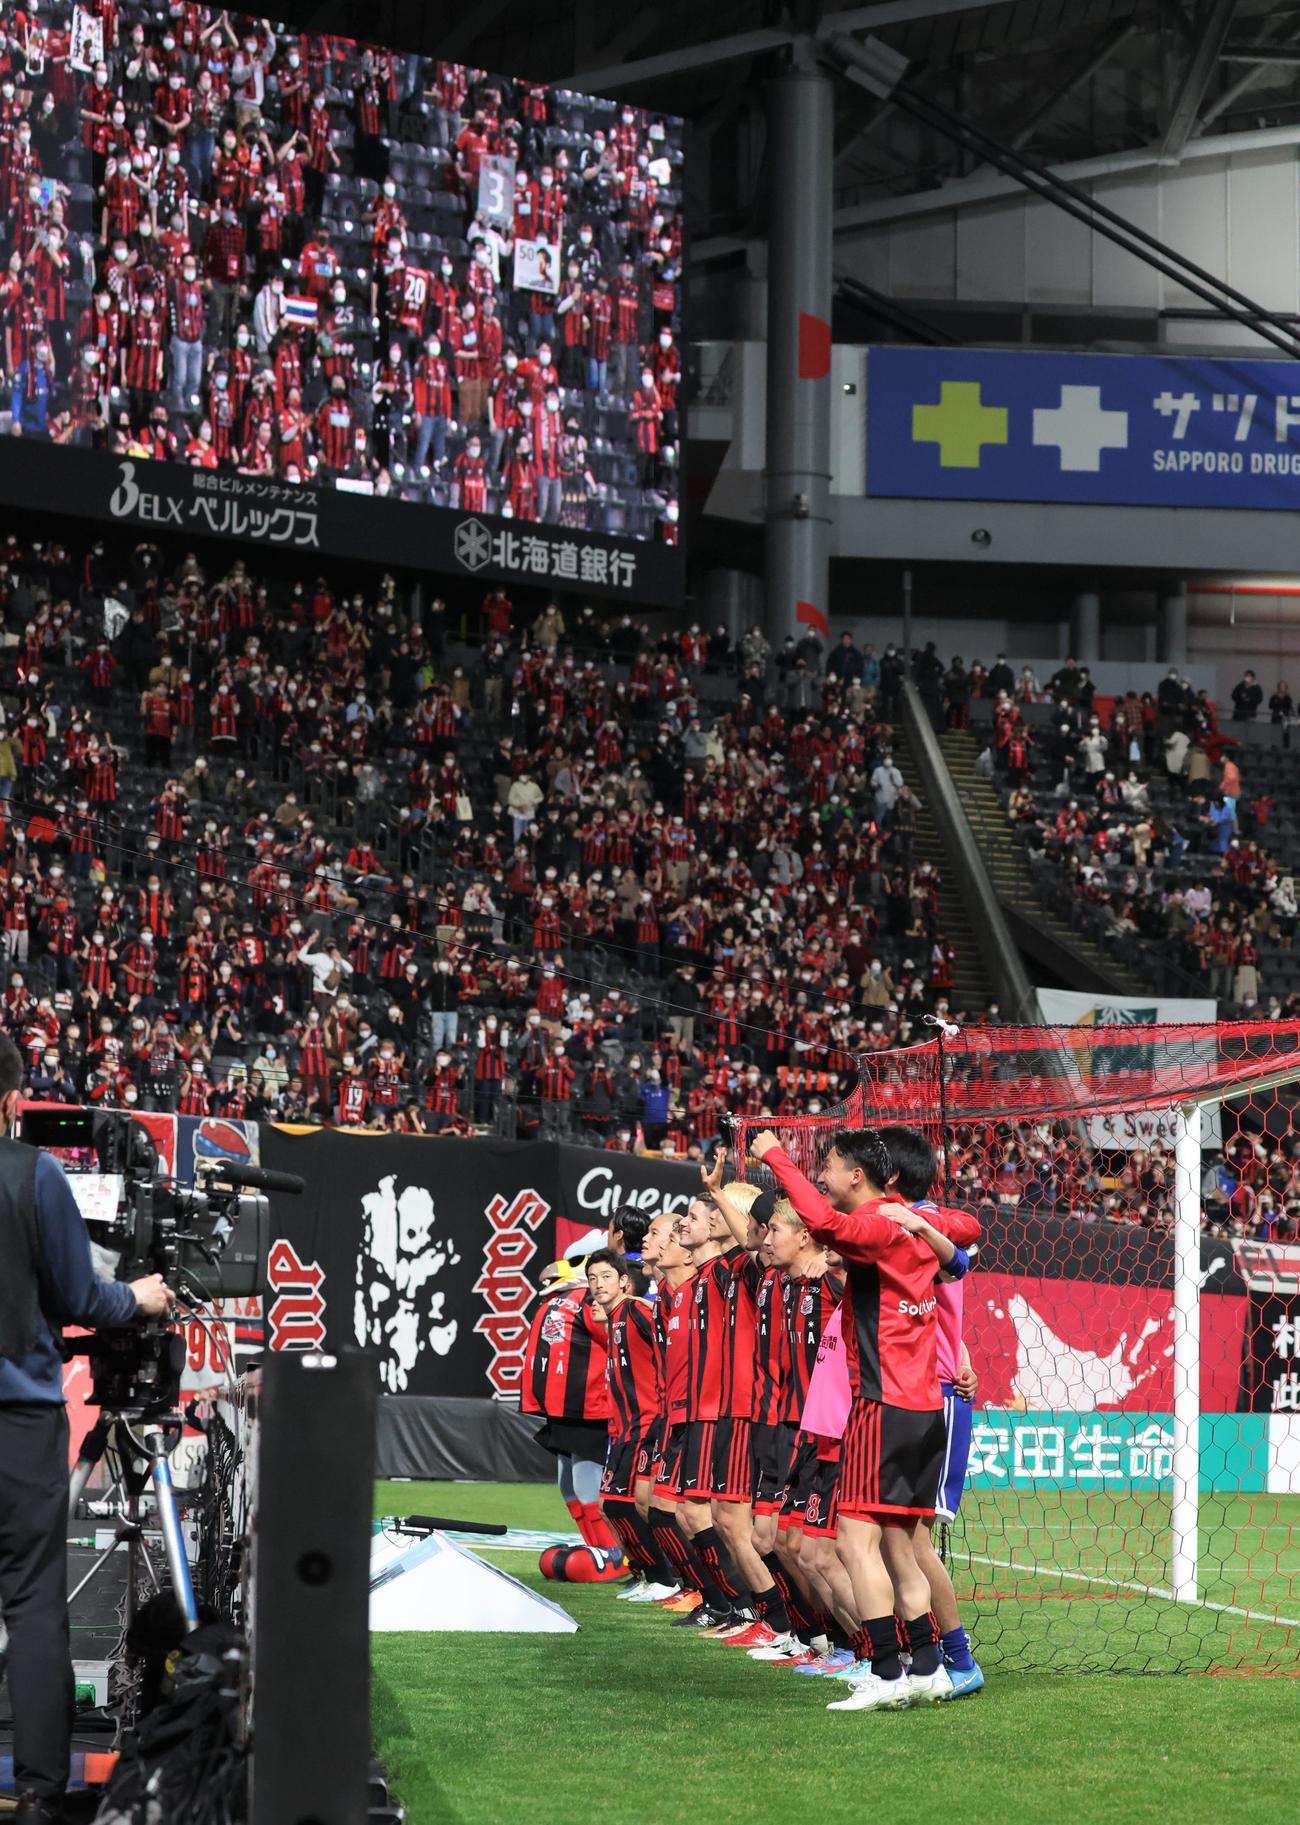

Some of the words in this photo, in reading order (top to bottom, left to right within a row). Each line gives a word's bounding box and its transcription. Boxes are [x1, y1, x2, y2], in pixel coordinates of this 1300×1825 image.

[404, 274, 426, 304] 20
[1153, 449, 1243, 473] SAPPORO
[1250, 452, 1300, 475] DRUG
[192, 473, 319, 506] 総合ビルメンテナンス
[189, 496, 320, 547] ベルックス
[492, 530, 637, 588] 北海道銀行
[576, 1166, 697, 1218] Guer
[471, 1188, 551, 1401] Sappo
[807, 1493, 821, 1523] 8
